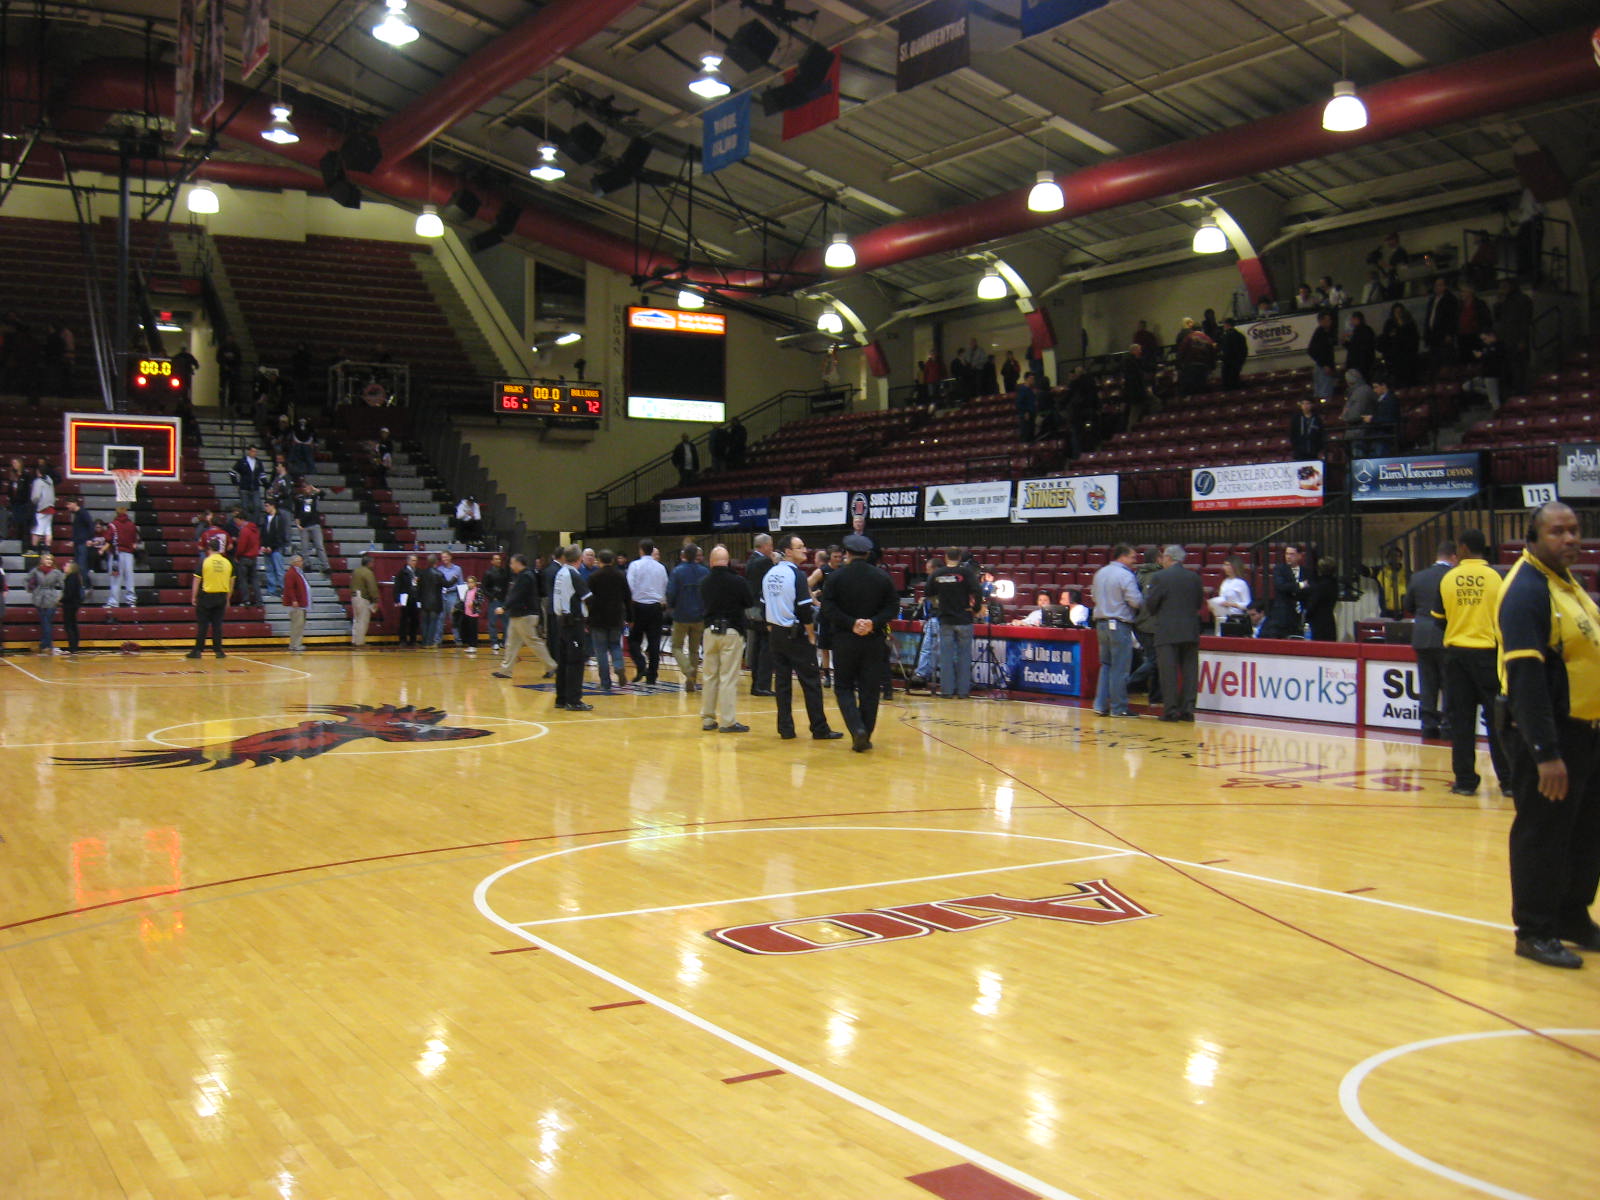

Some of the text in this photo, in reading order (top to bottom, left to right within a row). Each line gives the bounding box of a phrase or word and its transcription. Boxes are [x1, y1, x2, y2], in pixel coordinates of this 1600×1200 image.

[533, 387, 561, 401] 00.0
[502, 395, 520, 409] 66
[585, 400, 601, 414] 72
[1567, 449, 1596, 471] play
[1217, 466, 1291, 483] DREXELBROOK
[1022, 483, 1076, 512] STINGER
[1528, 488, 1551, 503] 113
[1456, 575, 1485, 587] CSC
[1456, 588, 1484, 597] EVENT
[1457, 598, 1482, 606] STAFF
[1035, 646, 1050, 662] Like
[1198, 660, 1348, 704] Wellworks
[1383, 668, 1421, 701] SU
[1383, 703, 1421, 721] Avail
